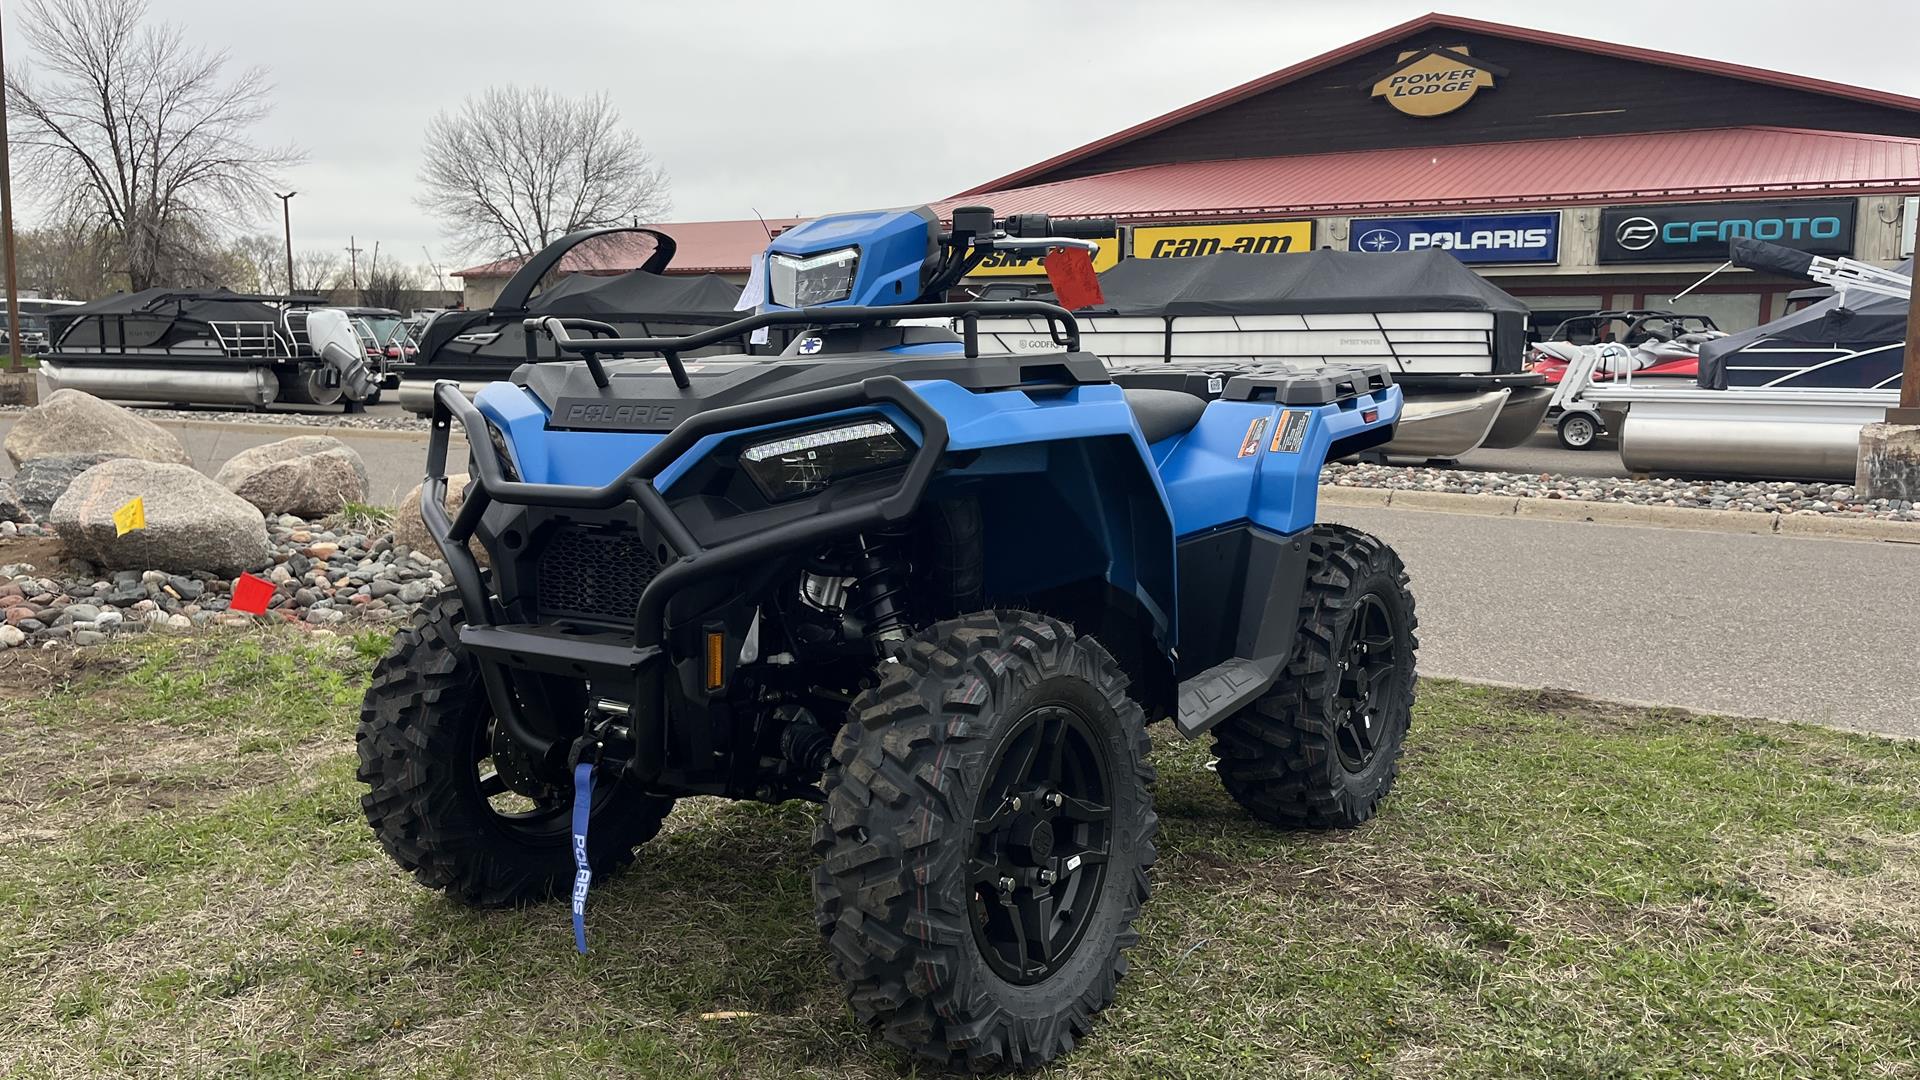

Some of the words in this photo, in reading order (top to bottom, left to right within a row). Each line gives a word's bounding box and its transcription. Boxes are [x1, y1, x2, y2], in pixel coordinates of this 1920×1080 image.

[1389, 69, 1476, 88] POWER
[1393, 81, 1472, 97] LODGE
[1409, 229, 1547, 250] POLARIS
[1662, 217, 1840, 243] CFMOTO
[567, 405, 676, 423] POLARIS
[574, 834, 590, 916] POLARIS
